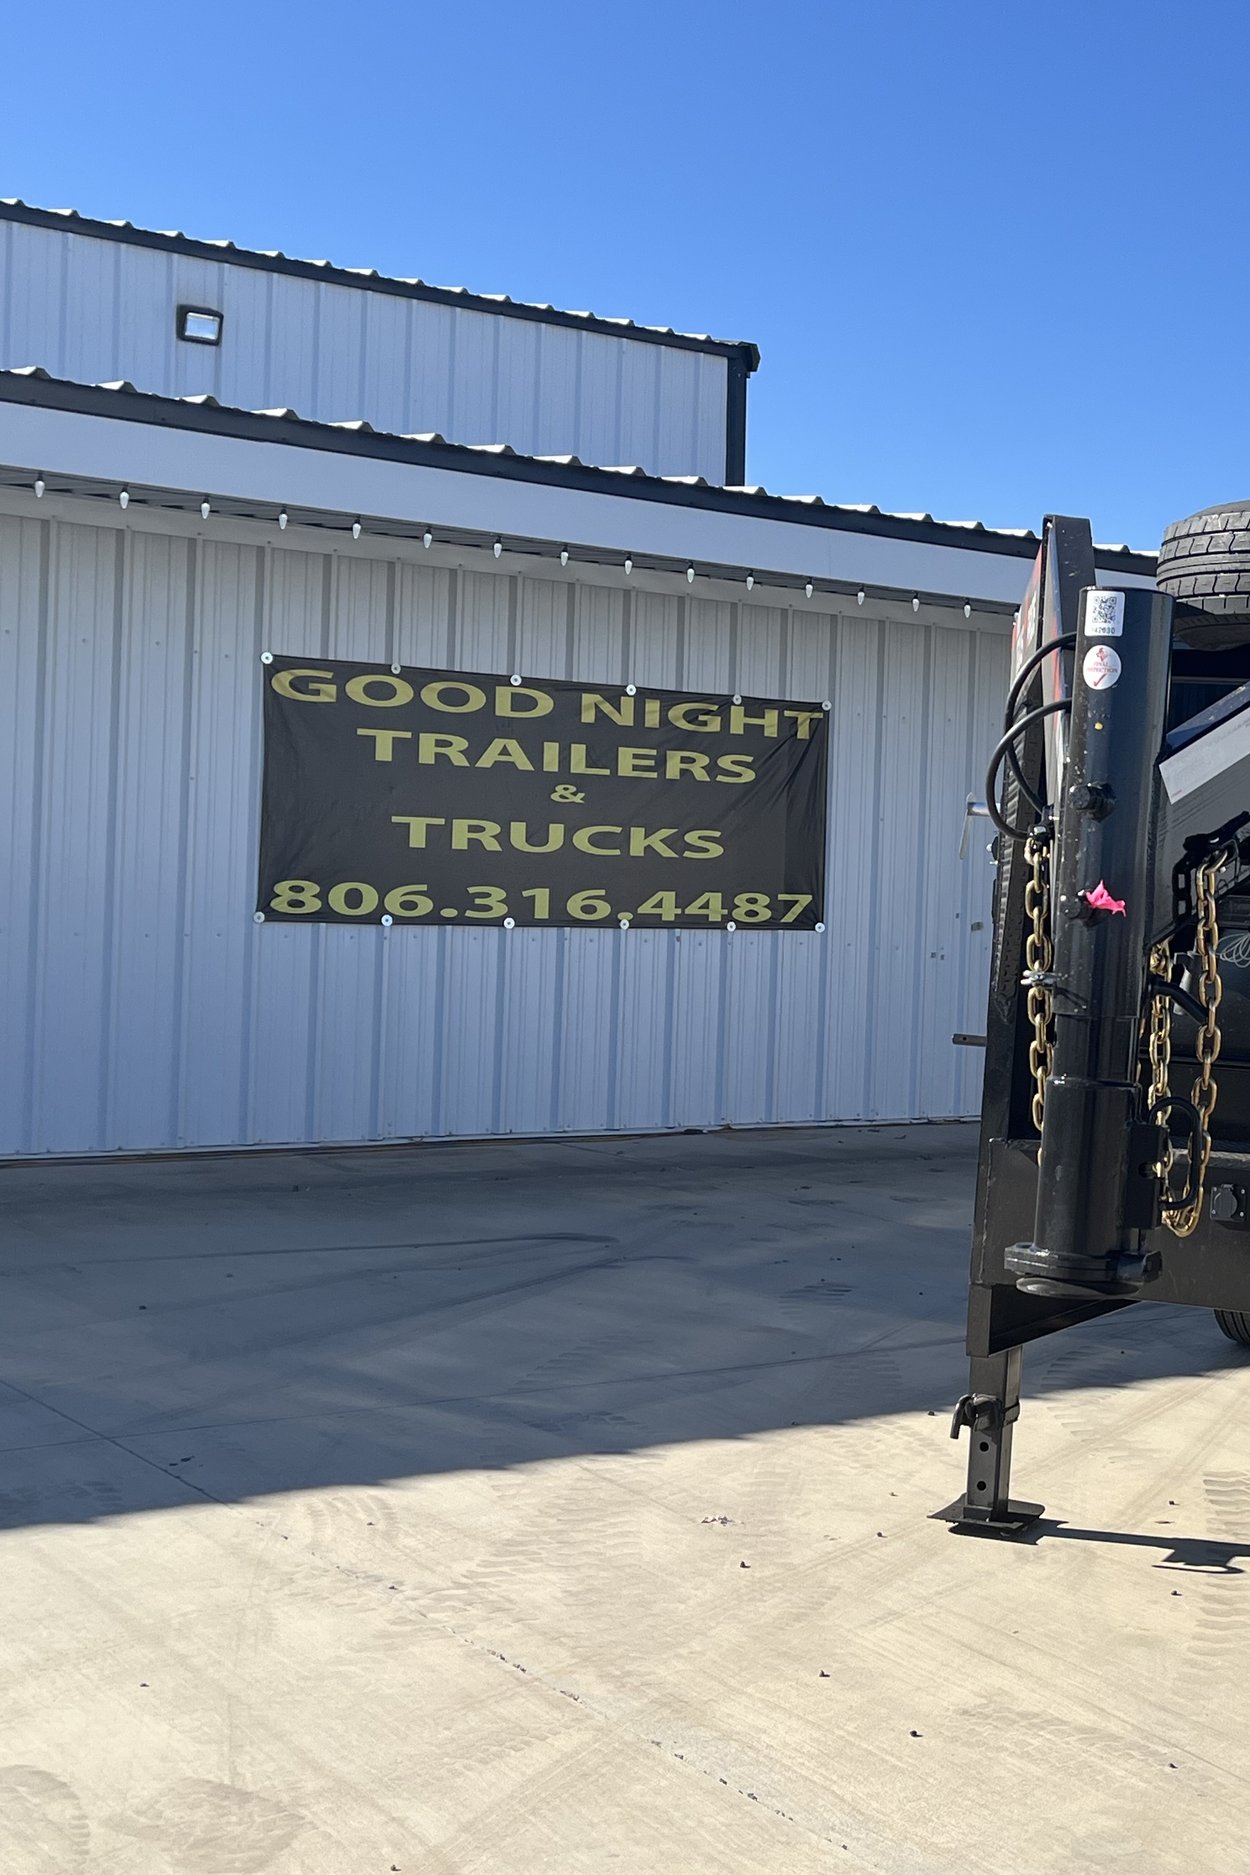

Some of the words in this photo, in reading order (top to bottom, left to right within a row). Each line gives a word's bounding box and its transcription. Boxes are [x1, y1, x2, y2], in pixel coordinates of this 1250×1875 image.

[271, 668, 555, 720] GOOD
[580, 692, 824, 740] NIGHT
[356, 727, 757, 784] TRAILERS
[550, 784, 585, 804] &
[391, 815, 724, 859] TRUCKS
[270, 879, 814, 924] 806.316.4487
